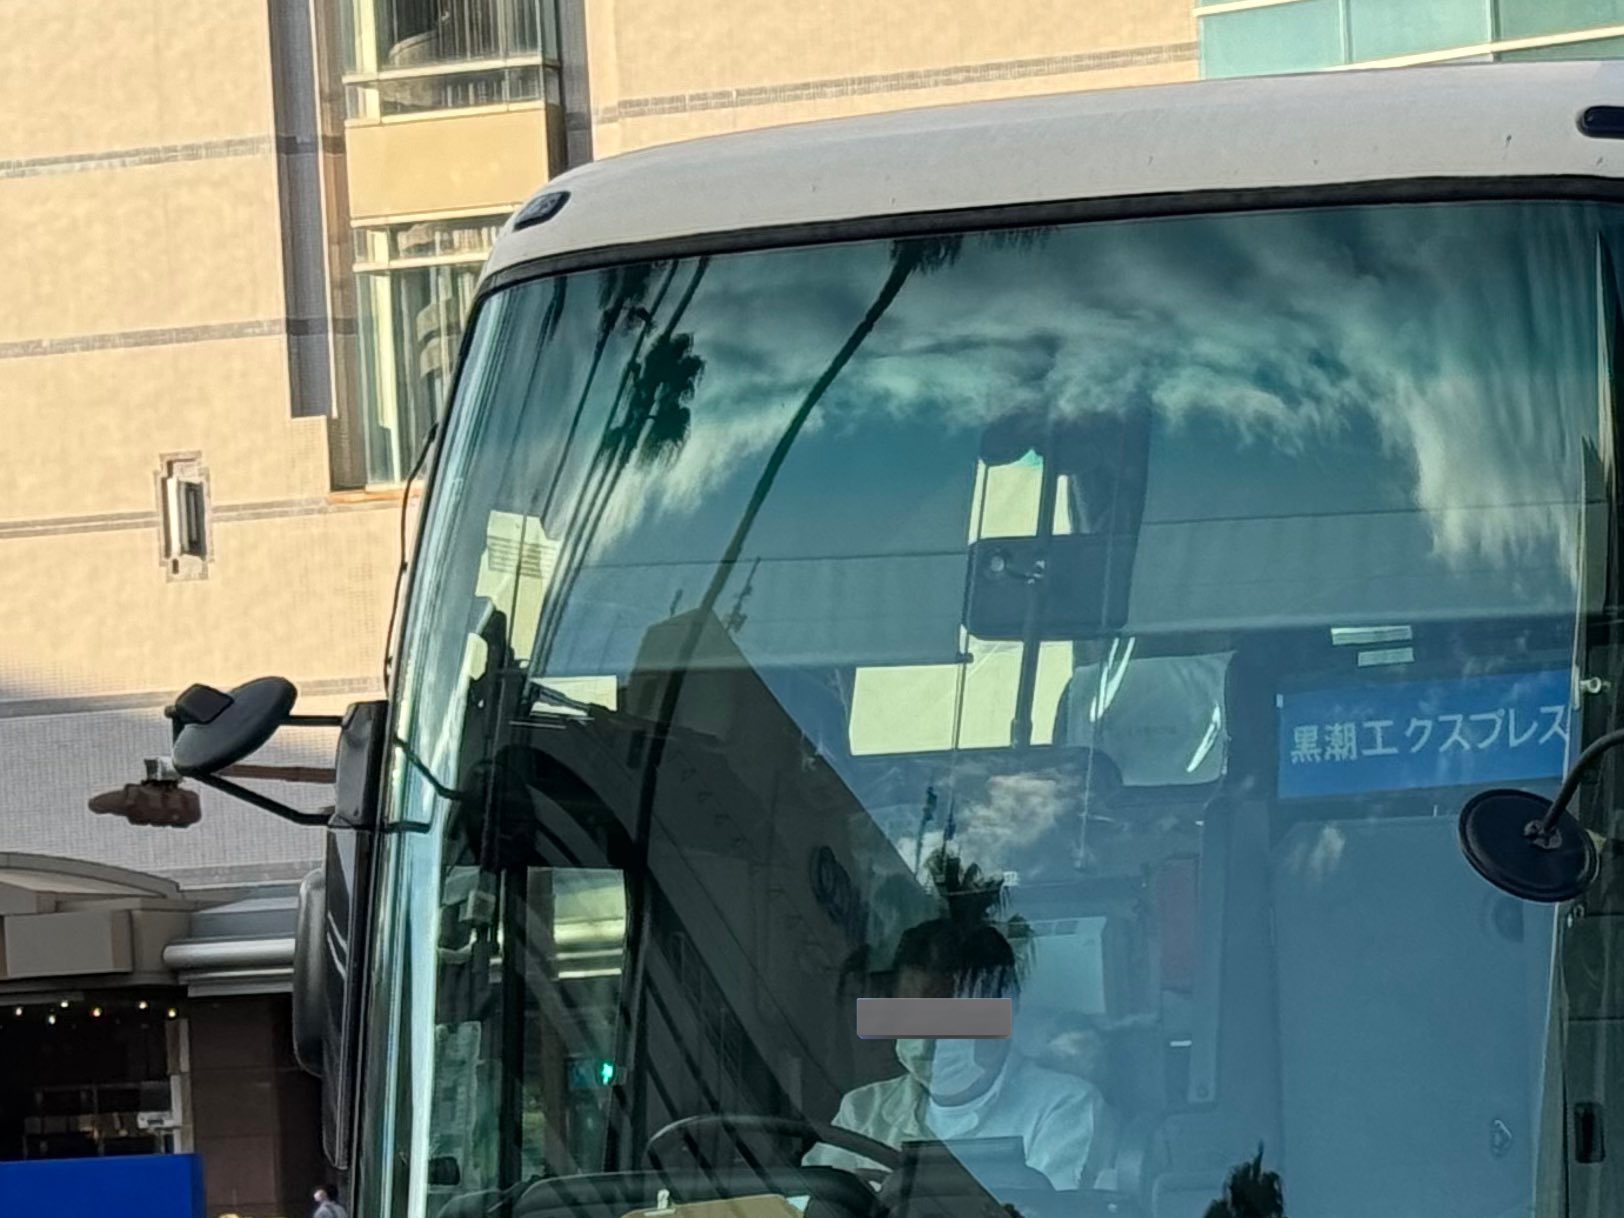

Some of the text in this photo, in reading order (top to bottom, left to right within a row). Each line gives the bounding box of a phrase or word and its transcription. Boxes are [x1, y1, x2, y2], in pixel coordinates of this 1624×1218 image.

[1290, 704, 1569, 764] 黒潮エクスプレス
